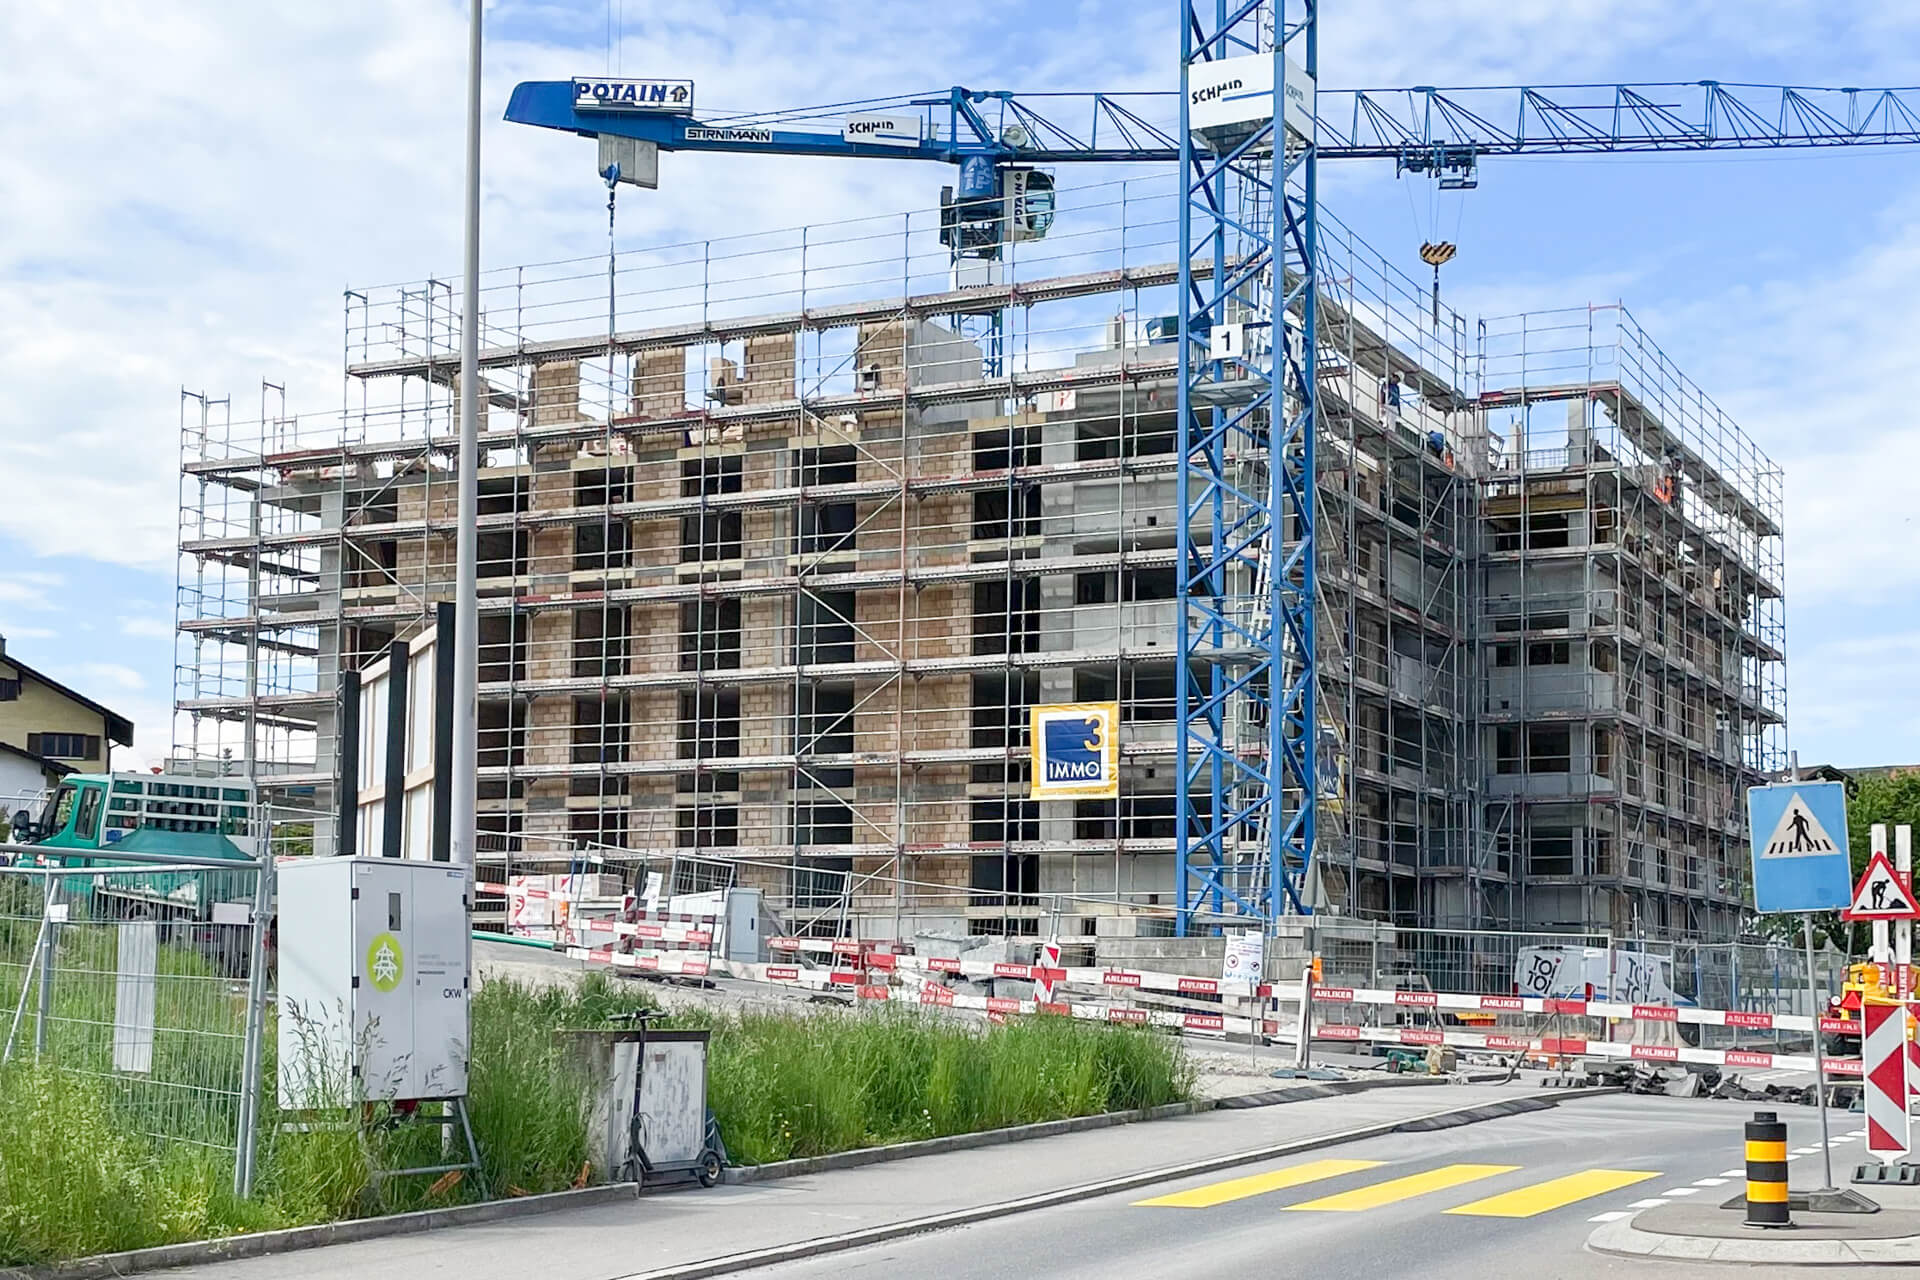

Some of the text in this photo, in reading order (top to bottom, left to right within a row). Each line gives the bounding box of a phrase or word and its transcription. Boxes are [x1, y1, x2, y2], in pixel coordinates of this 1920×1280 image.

[576, 83, 667, 102] POTAIN
[1191, 79, 1243, 105] SCHMID
[848, 120, 894, 134] SCHMID
[687, 128, 770, 142] STIRNIMANN
[1014, 182, 1023, 225] POTAIN
[1221, 331, 1231, 351] 1
[1084, 714, 1105, 752] 3
[1049, 761, 1100, 779] IMMO
[1105, 975, 1140, 985] ANLIKER
[1180, 980, 1216, 991] ANLIKER
[442, 988, 462, 999] CKW
[1314, 989, 1352, 999] ANLIKER
[1397, 994, 1436, 1004] ANLIKER
[1482, 998, 1522, 1009] ANLIKER
[1185, 1017, 1222, 1027] ANLIKER
[1727, 1014, 1769, 1025] ANLIKER
[1633, 1047, 1676, 1058] ANLIKER
[1727, 1054, 1769, 1065] ANLIKER
